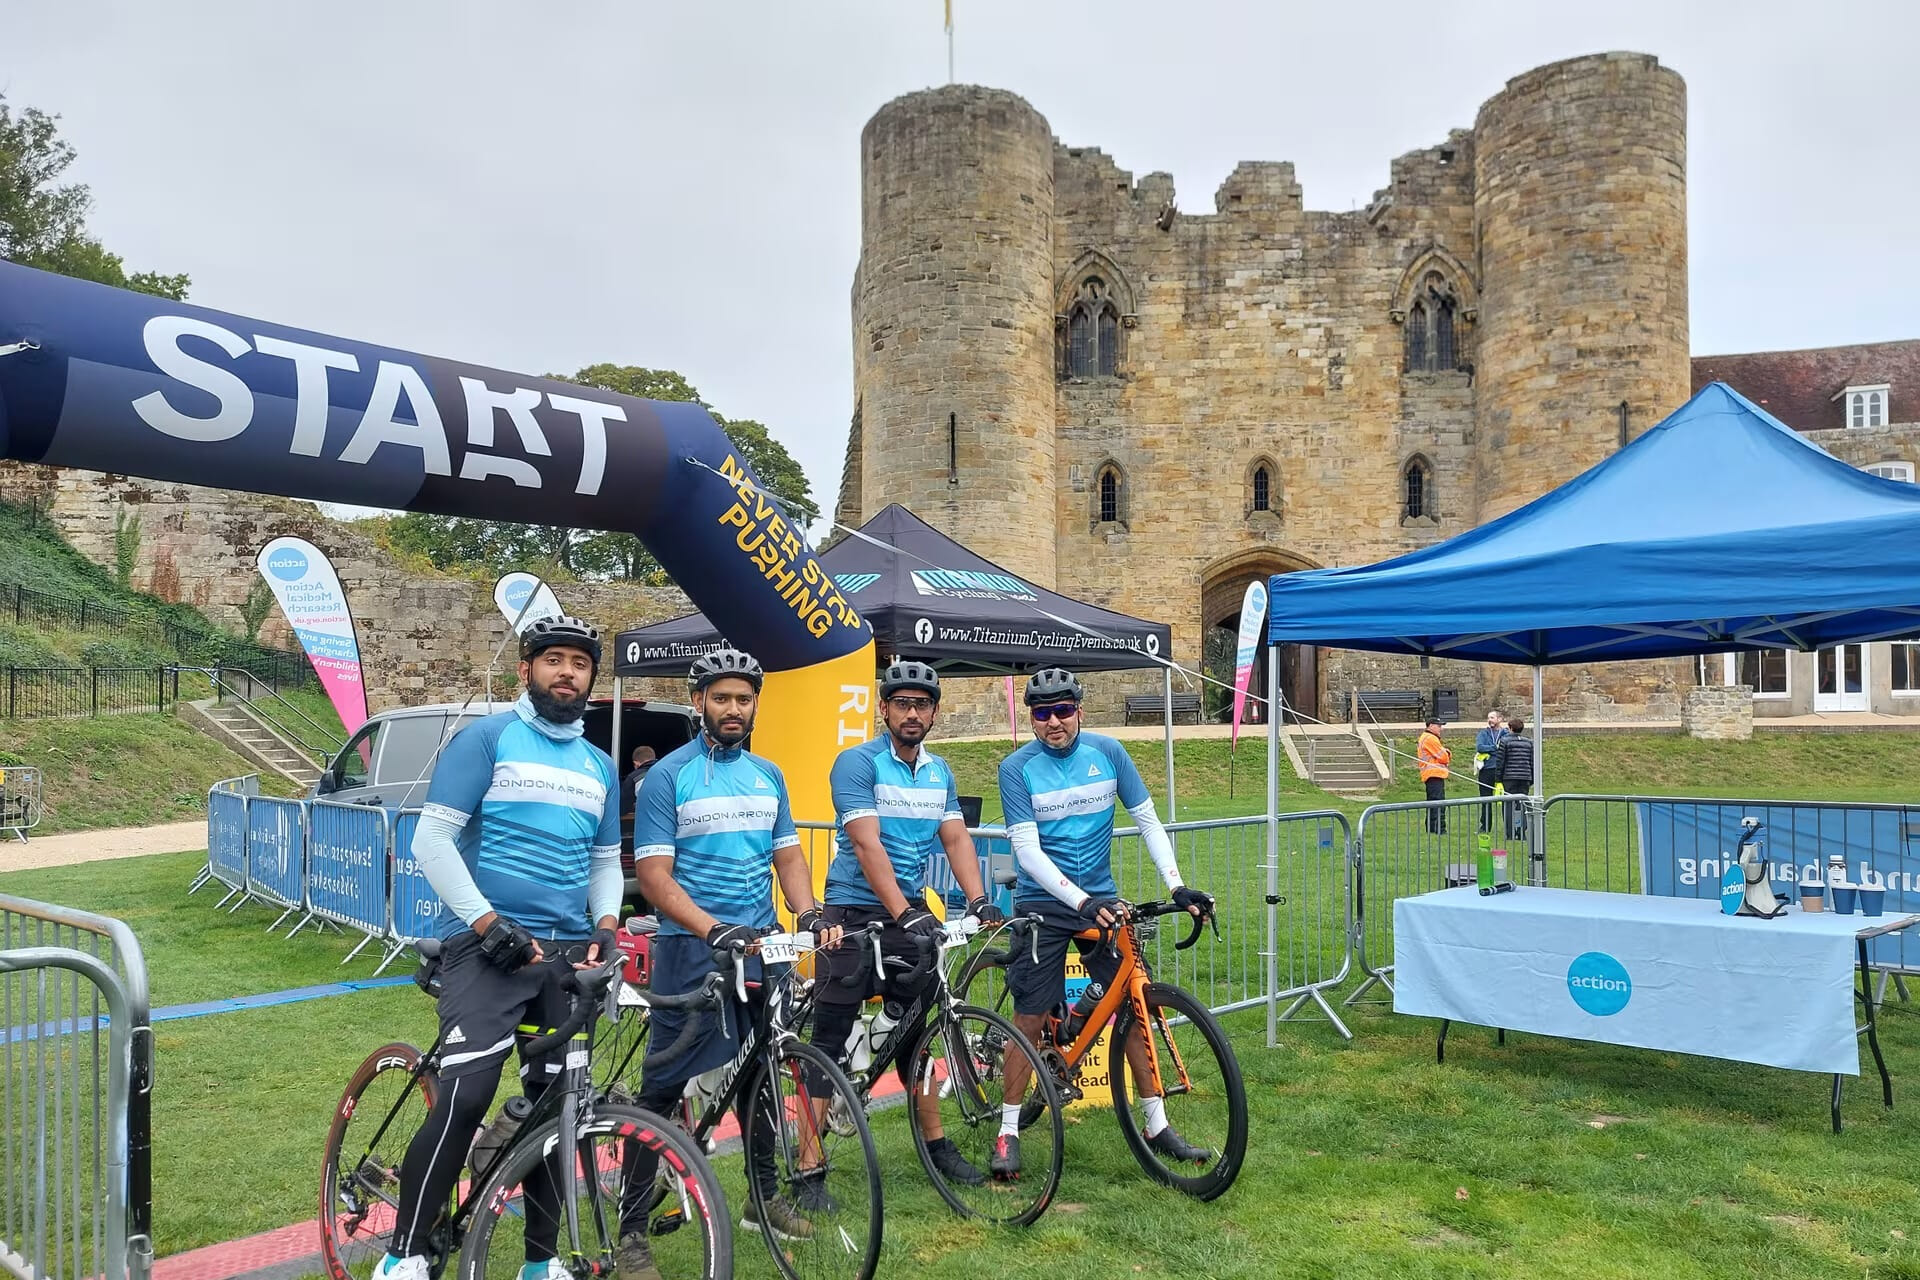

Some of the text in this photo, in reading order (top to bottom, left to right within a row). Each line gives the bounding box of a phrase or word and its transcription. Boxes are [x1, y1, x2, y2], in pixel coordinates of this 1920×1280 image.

[132, 315, 628, 496] START
[719, 454, 803, 562] NEVER
[802, 558, 861, 629] STOP
[718, 502, 833, 639] PUSHING
[939, 626, 1141, 651] www.TitaniumCyclingEvents.co.uk
[876, 798, 911, 807] ONDON
[1034, 803, 1065, 814] NDON
[1067, 793, 1107, 808] ARROWS
[1722, 880, 1745, 897] action
[765, 944, 796, 959] 3118
[1570, 974, 1628, 993] action
